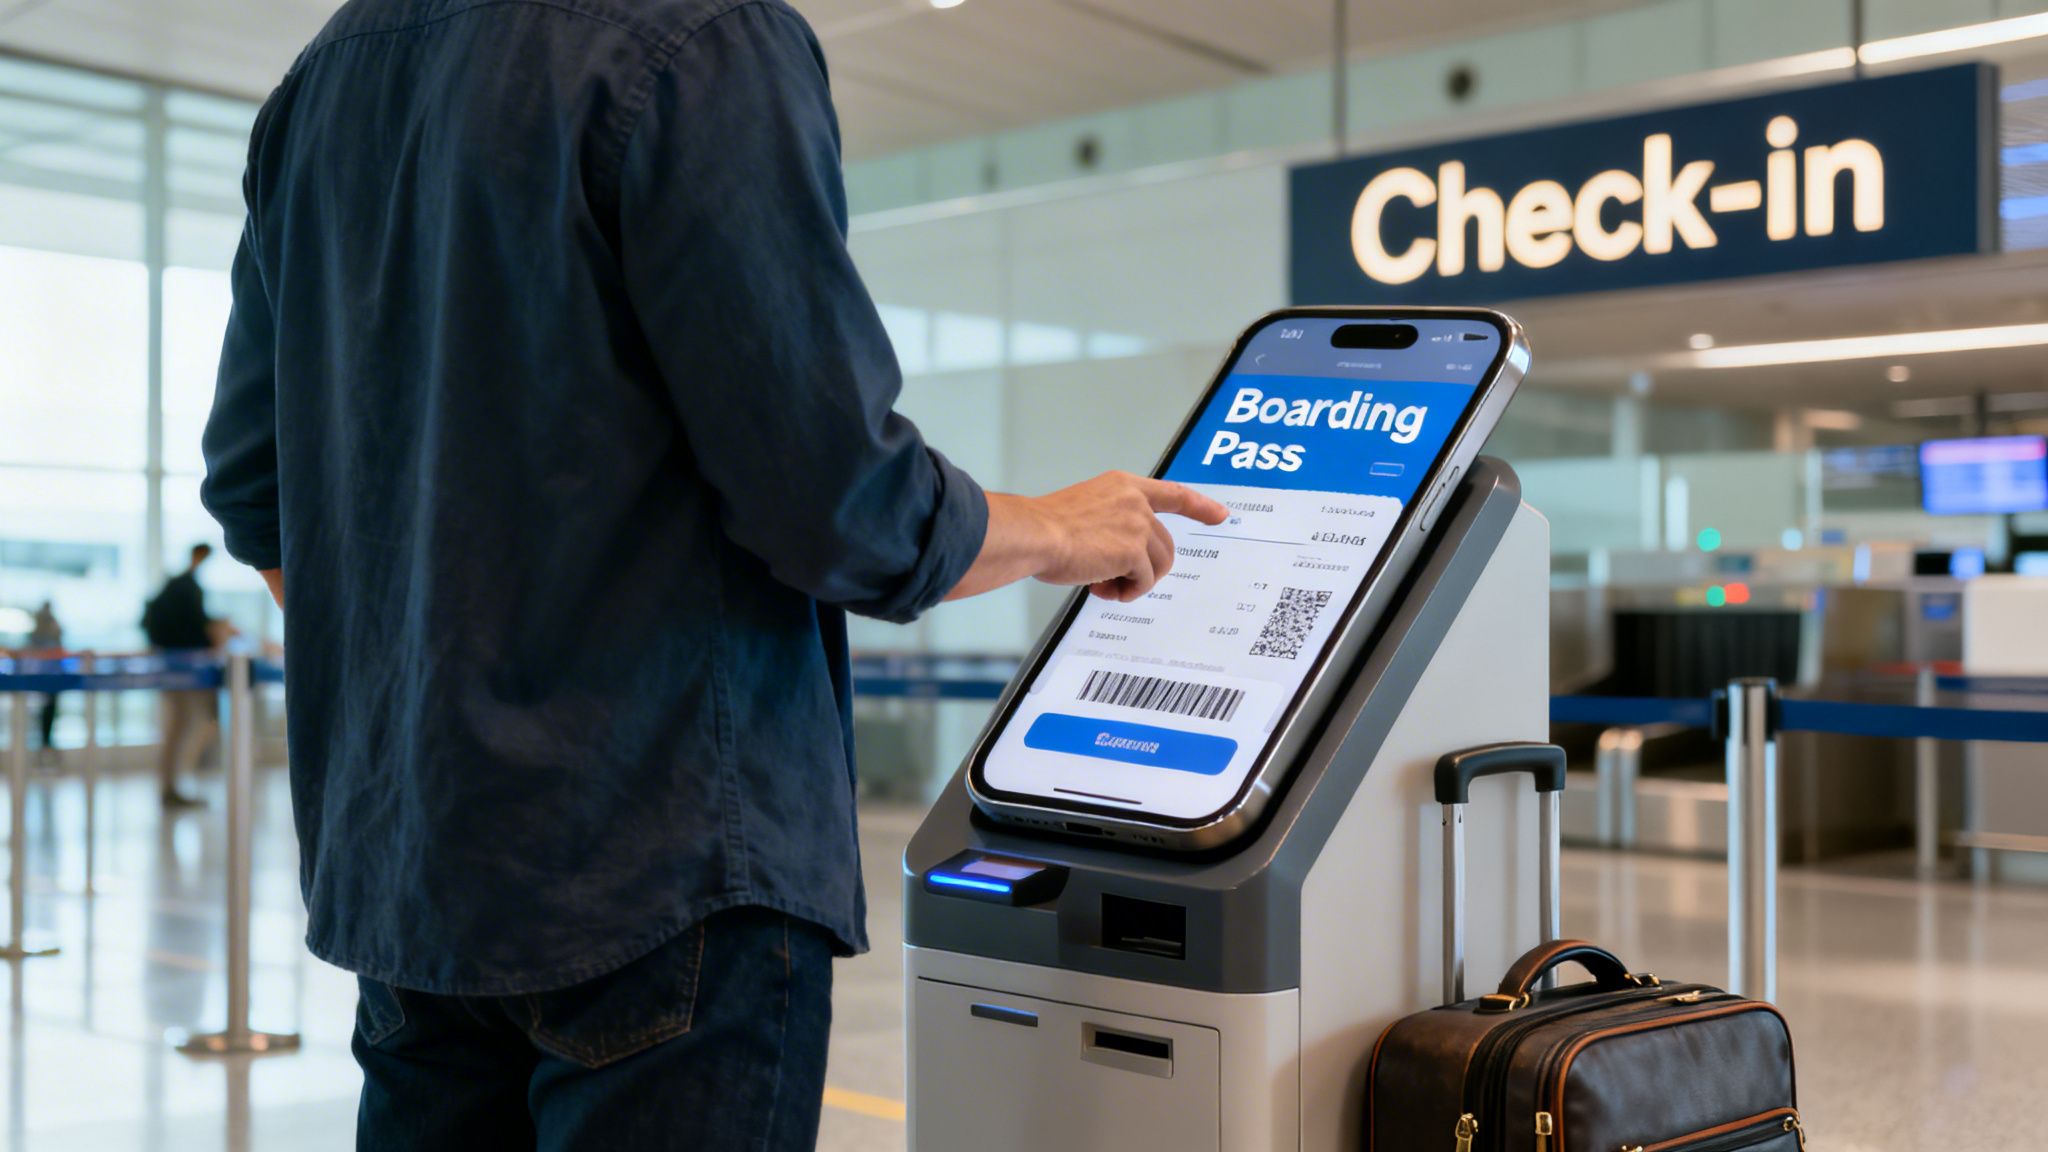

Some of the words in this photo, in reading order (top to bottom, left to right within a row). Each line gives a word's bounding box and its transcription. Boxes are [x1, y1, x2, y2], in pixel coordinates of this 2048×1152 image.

[1351, 115, 1884, 284] Check-in
[1225, 387, 1428, 444] Boarding
[1201, 430, 1306, 472] Pass
